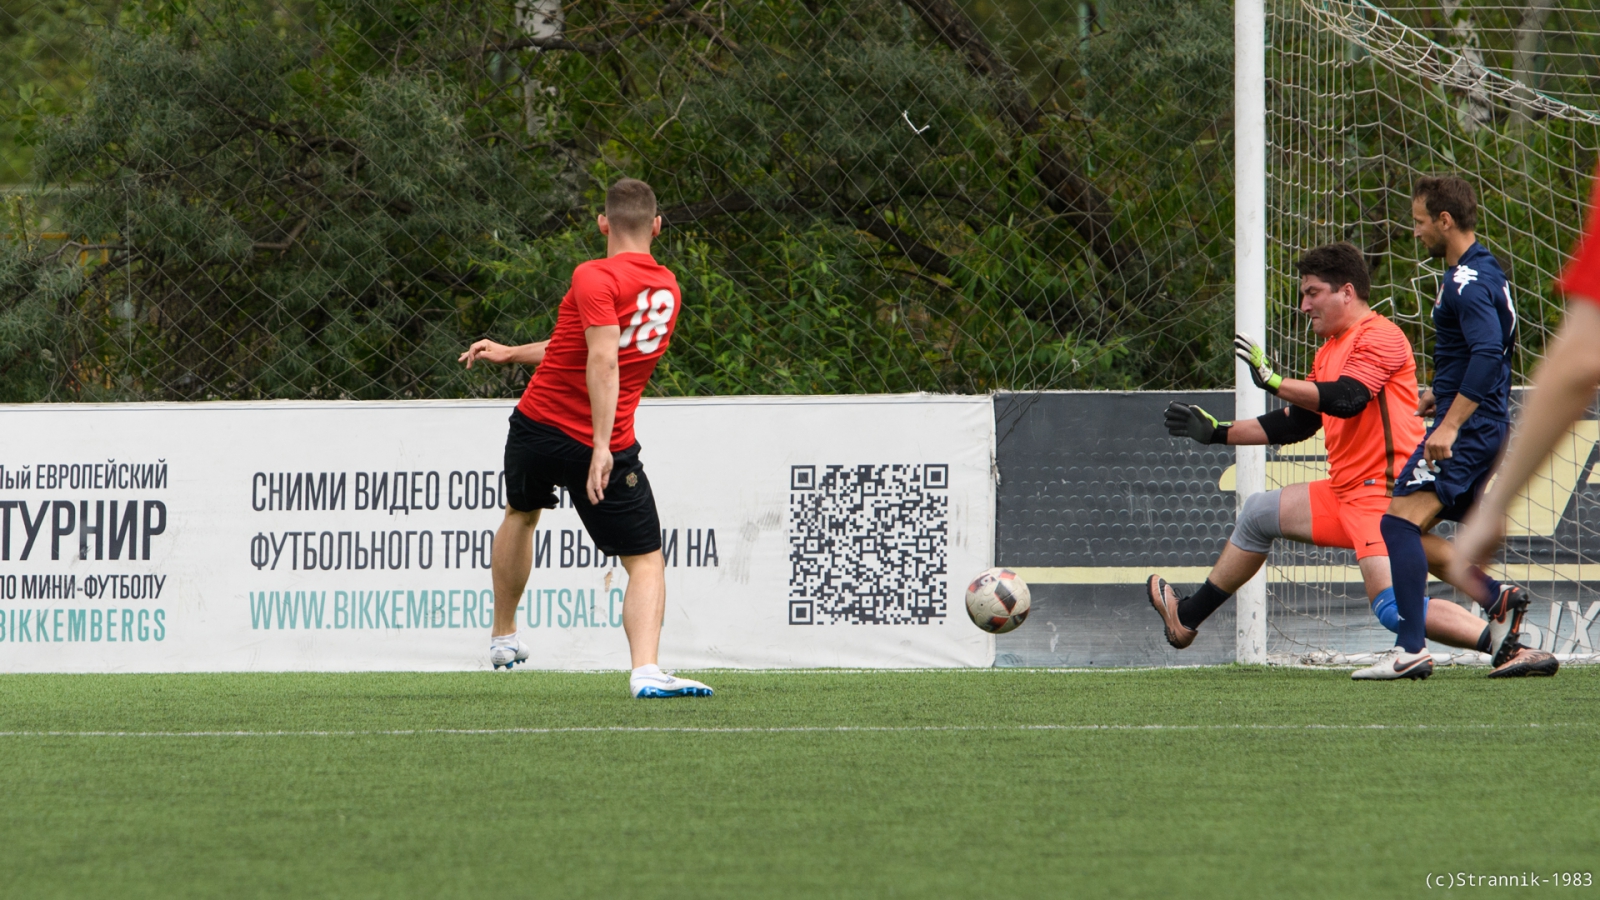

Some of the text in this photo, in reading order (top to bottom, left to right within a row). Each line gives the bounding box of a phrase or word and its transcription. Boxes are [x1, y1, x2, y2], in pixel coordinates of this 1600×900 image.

[619, 288, 675, 354] 18
[36, 458, 168, 490] ЕВРОПЕЙСКИЙ
[252, 471, 347, 512] СНИМИ
[354, 470, 440, 516] ВИДЕО
[0, 499, 168, 561] ТУРНИР
[250, 529, 433, 571] ФУТБОЛЬНОГО
[686, 528, 719, 568] НА
[21, 574, 167, 600] МИНИ-ФУТБОЛУ
